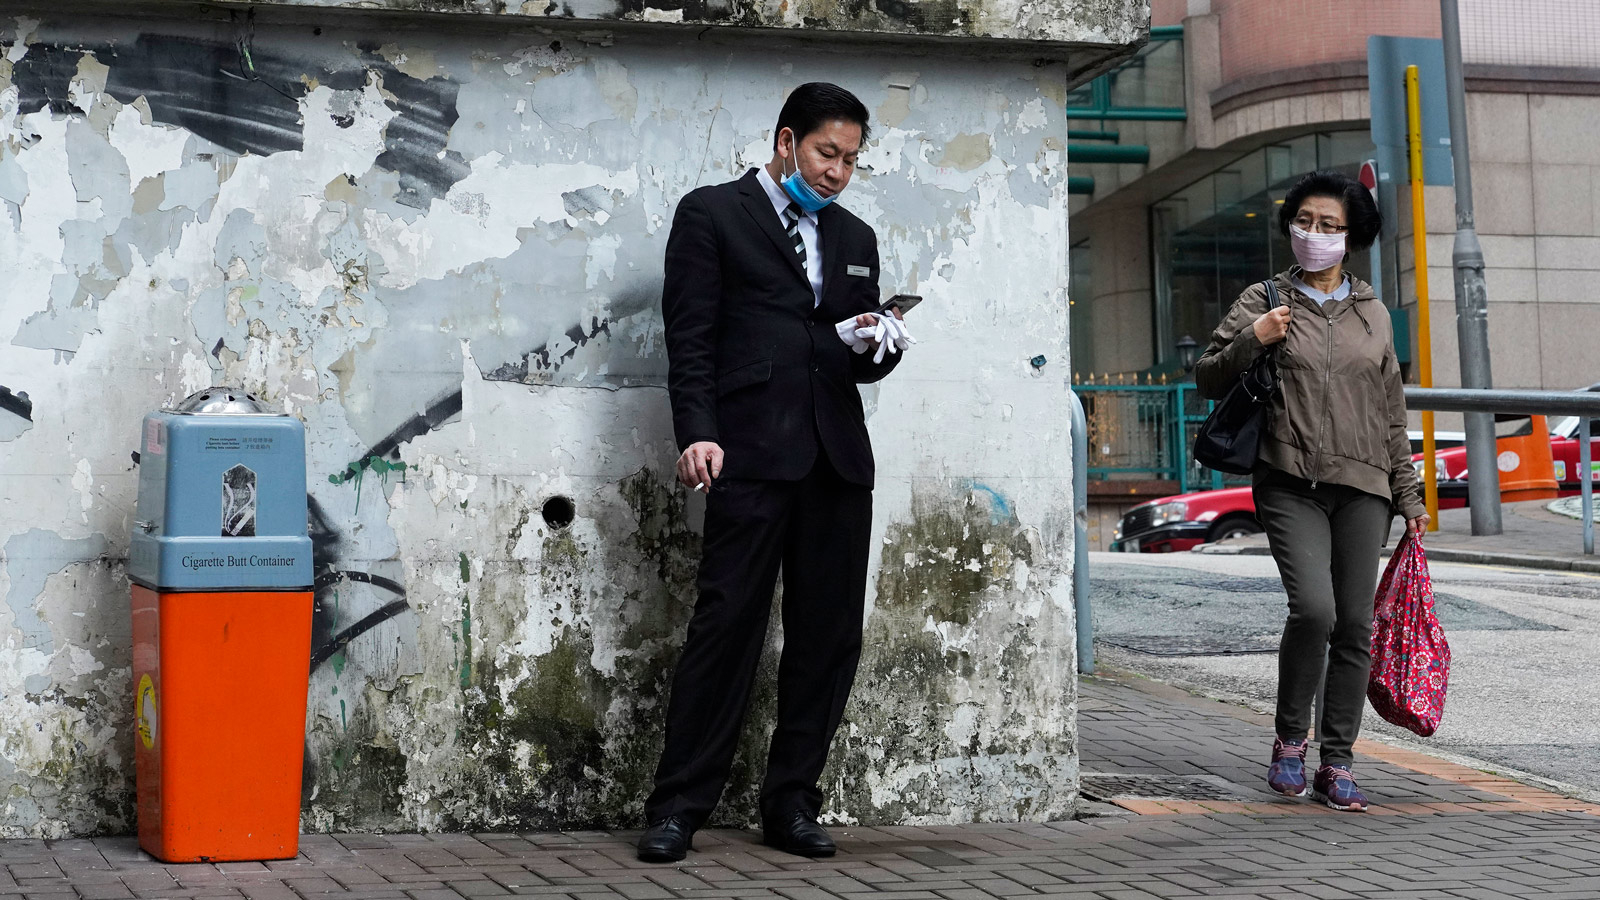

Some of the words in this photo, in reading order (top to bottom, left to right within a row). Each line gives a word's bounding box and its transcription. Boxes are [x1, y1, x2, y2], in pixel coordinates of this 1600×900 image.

[182, 556, 225, 570] Cigarette
[227, 555, 247, 567] Butt
[249, 555, 295, 567] Container
